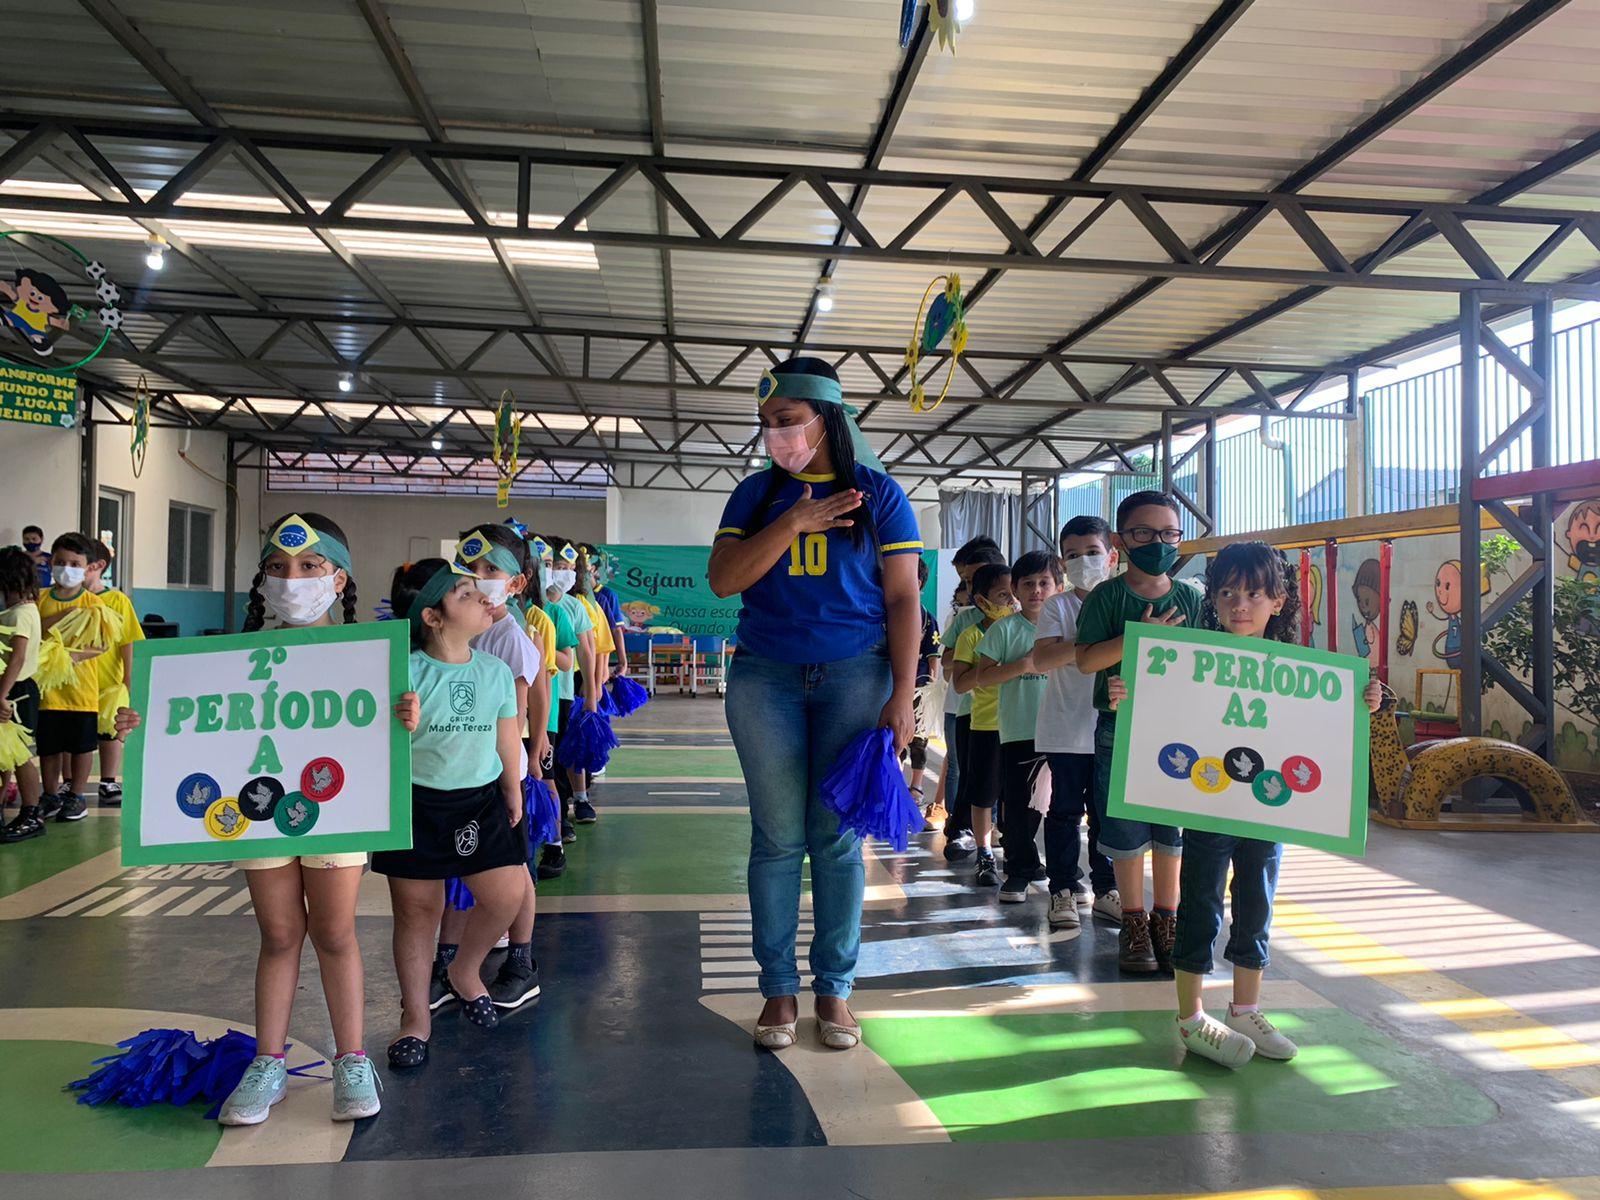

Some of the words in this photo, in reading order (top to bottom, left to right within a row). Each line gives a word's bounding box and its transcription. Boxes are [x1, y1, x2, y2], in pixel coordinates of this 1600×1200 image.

[53, 388, 74, 401] EM
[15, 396, 68, 412] LUGAR
[0, 408, 52, 424] ELHOR
[788, 533, 828, 576] 10
[626, 566, 696, 596] Sejam
[664, 606, 706, 618] Nossa
[669, 620, 725, 634] Quando
[1191, 650, 1343, 702] PERÍODO
[165, 680, 378, 736] PERÍODO
[1221, 691, 1268, 730] A2
[449, 715, 476, 723] GRUPO
[428, 723, 461, 733] Madre
[462, 723, 493, 732] Tereza
[248, 734, 284, 775] A
